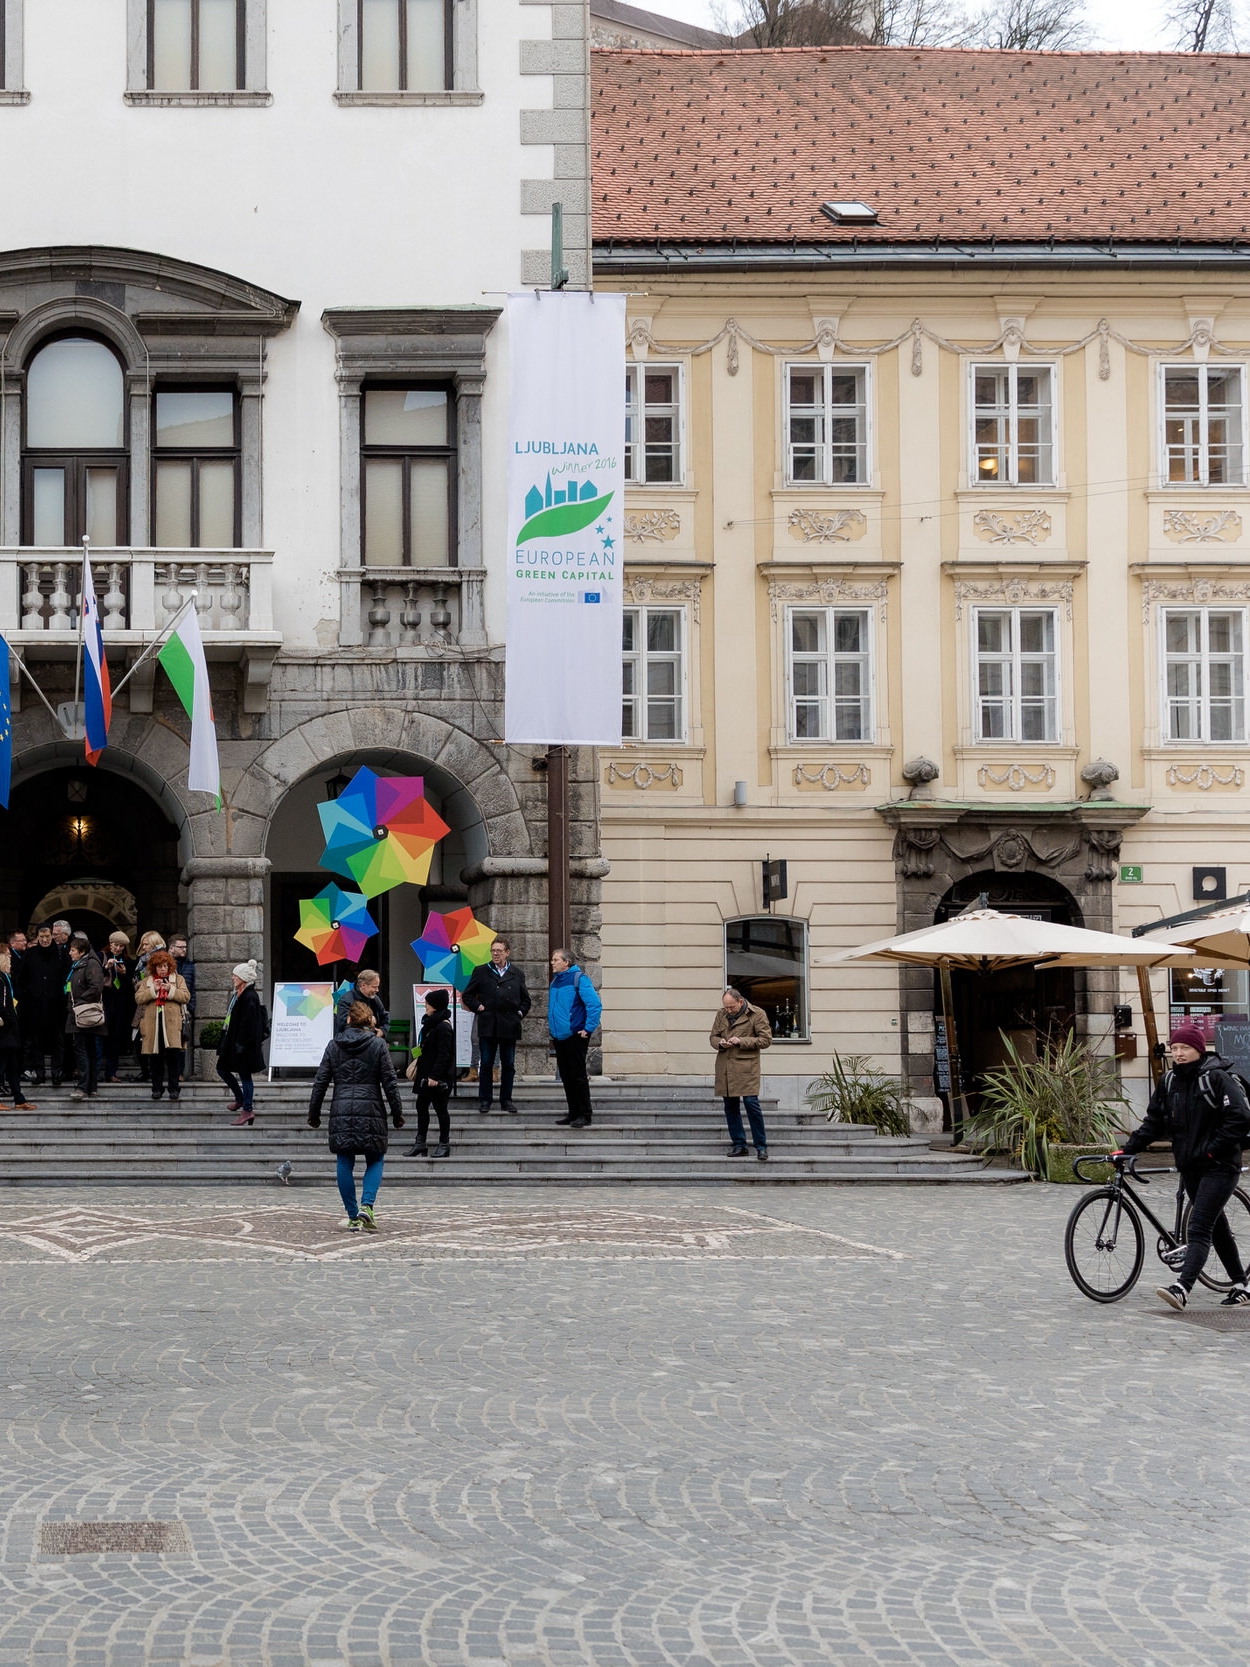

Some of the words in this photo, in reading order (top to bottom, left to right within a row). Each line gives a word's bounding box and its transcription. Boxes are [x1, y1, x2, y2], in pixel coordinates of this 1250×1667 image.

[515, 440, 599, 456] LJUBLJANA
[595, 456, 617, 470] 2016
[515, 549, 615, 567] EUROPEAN
[515, 569, 556, 580] GREEN
[561, 570, 615, 581] CAPITAL
[1128, 867, 1134, 876] 2
